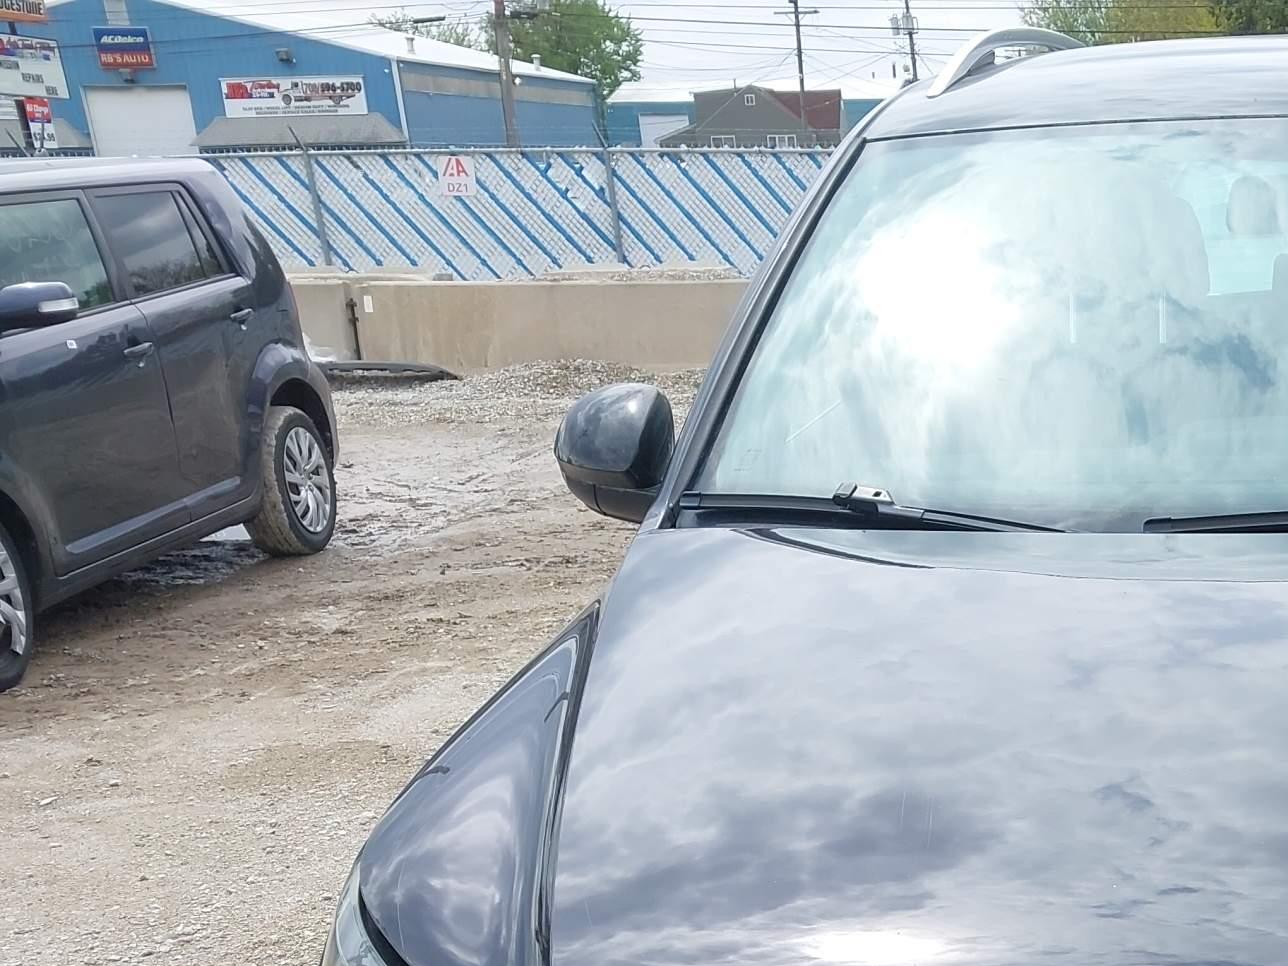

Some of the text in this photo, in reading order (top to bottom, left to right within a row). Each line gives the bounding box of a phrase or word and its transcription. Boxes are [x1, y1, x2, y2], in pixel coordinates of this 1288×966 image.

[100, 35, 144, 44] ACDelco
[123, 54, 149, 63] AUTO
[447, 182, 468, 193] DZ1
